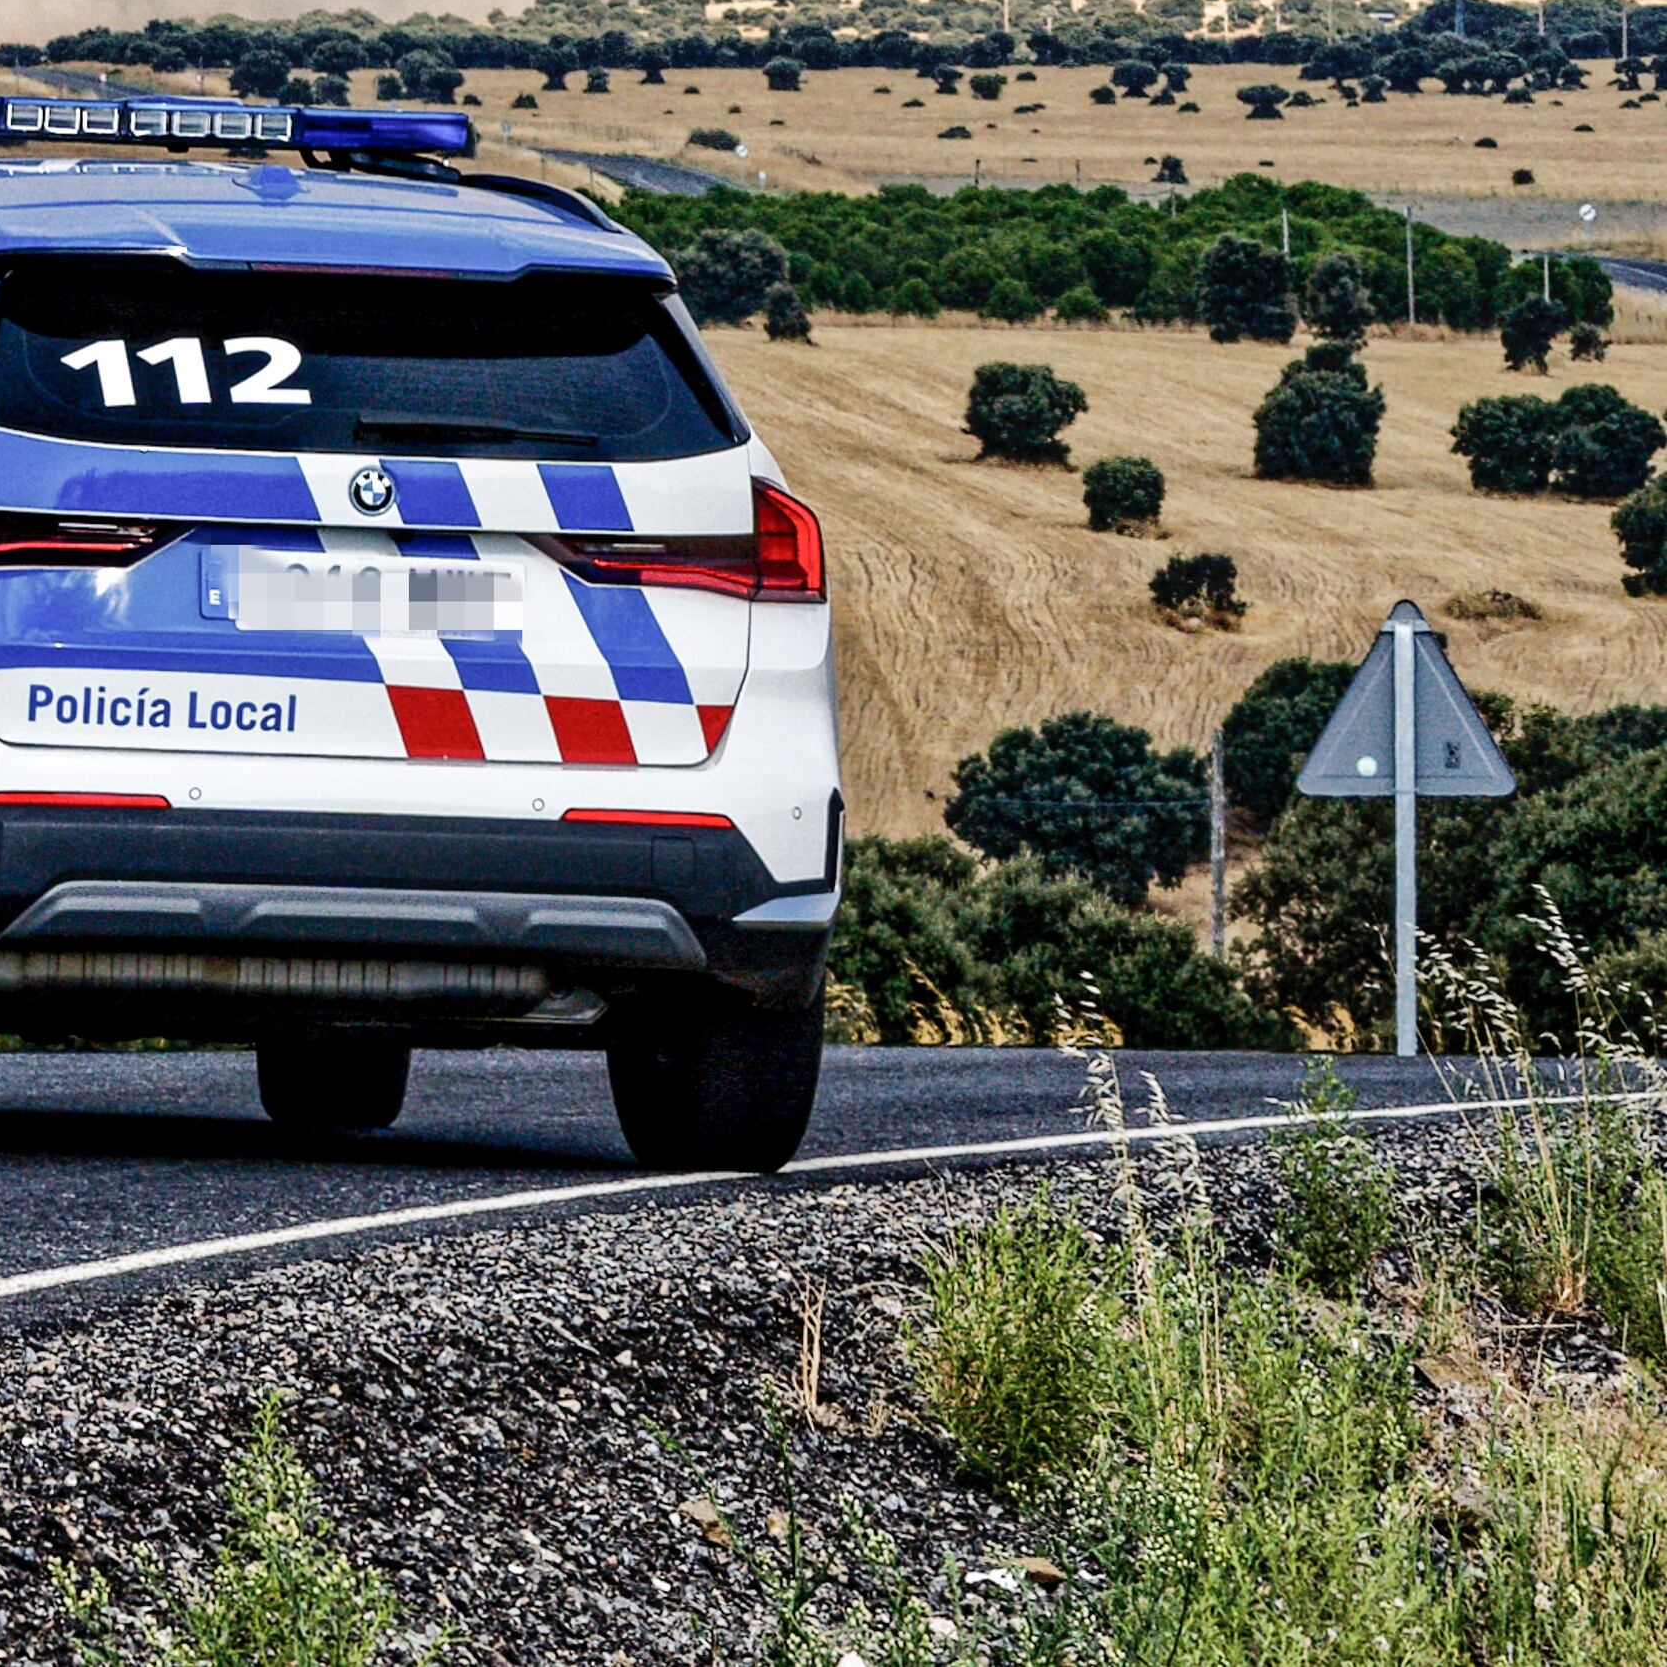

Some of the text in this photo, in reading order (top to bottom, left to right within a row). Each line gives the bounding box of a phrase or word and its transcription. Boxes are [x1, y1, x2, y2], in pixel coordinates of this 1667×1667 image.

[60, 337, 312, 407] 112
[27, 683, 297, 733] Policía Local
